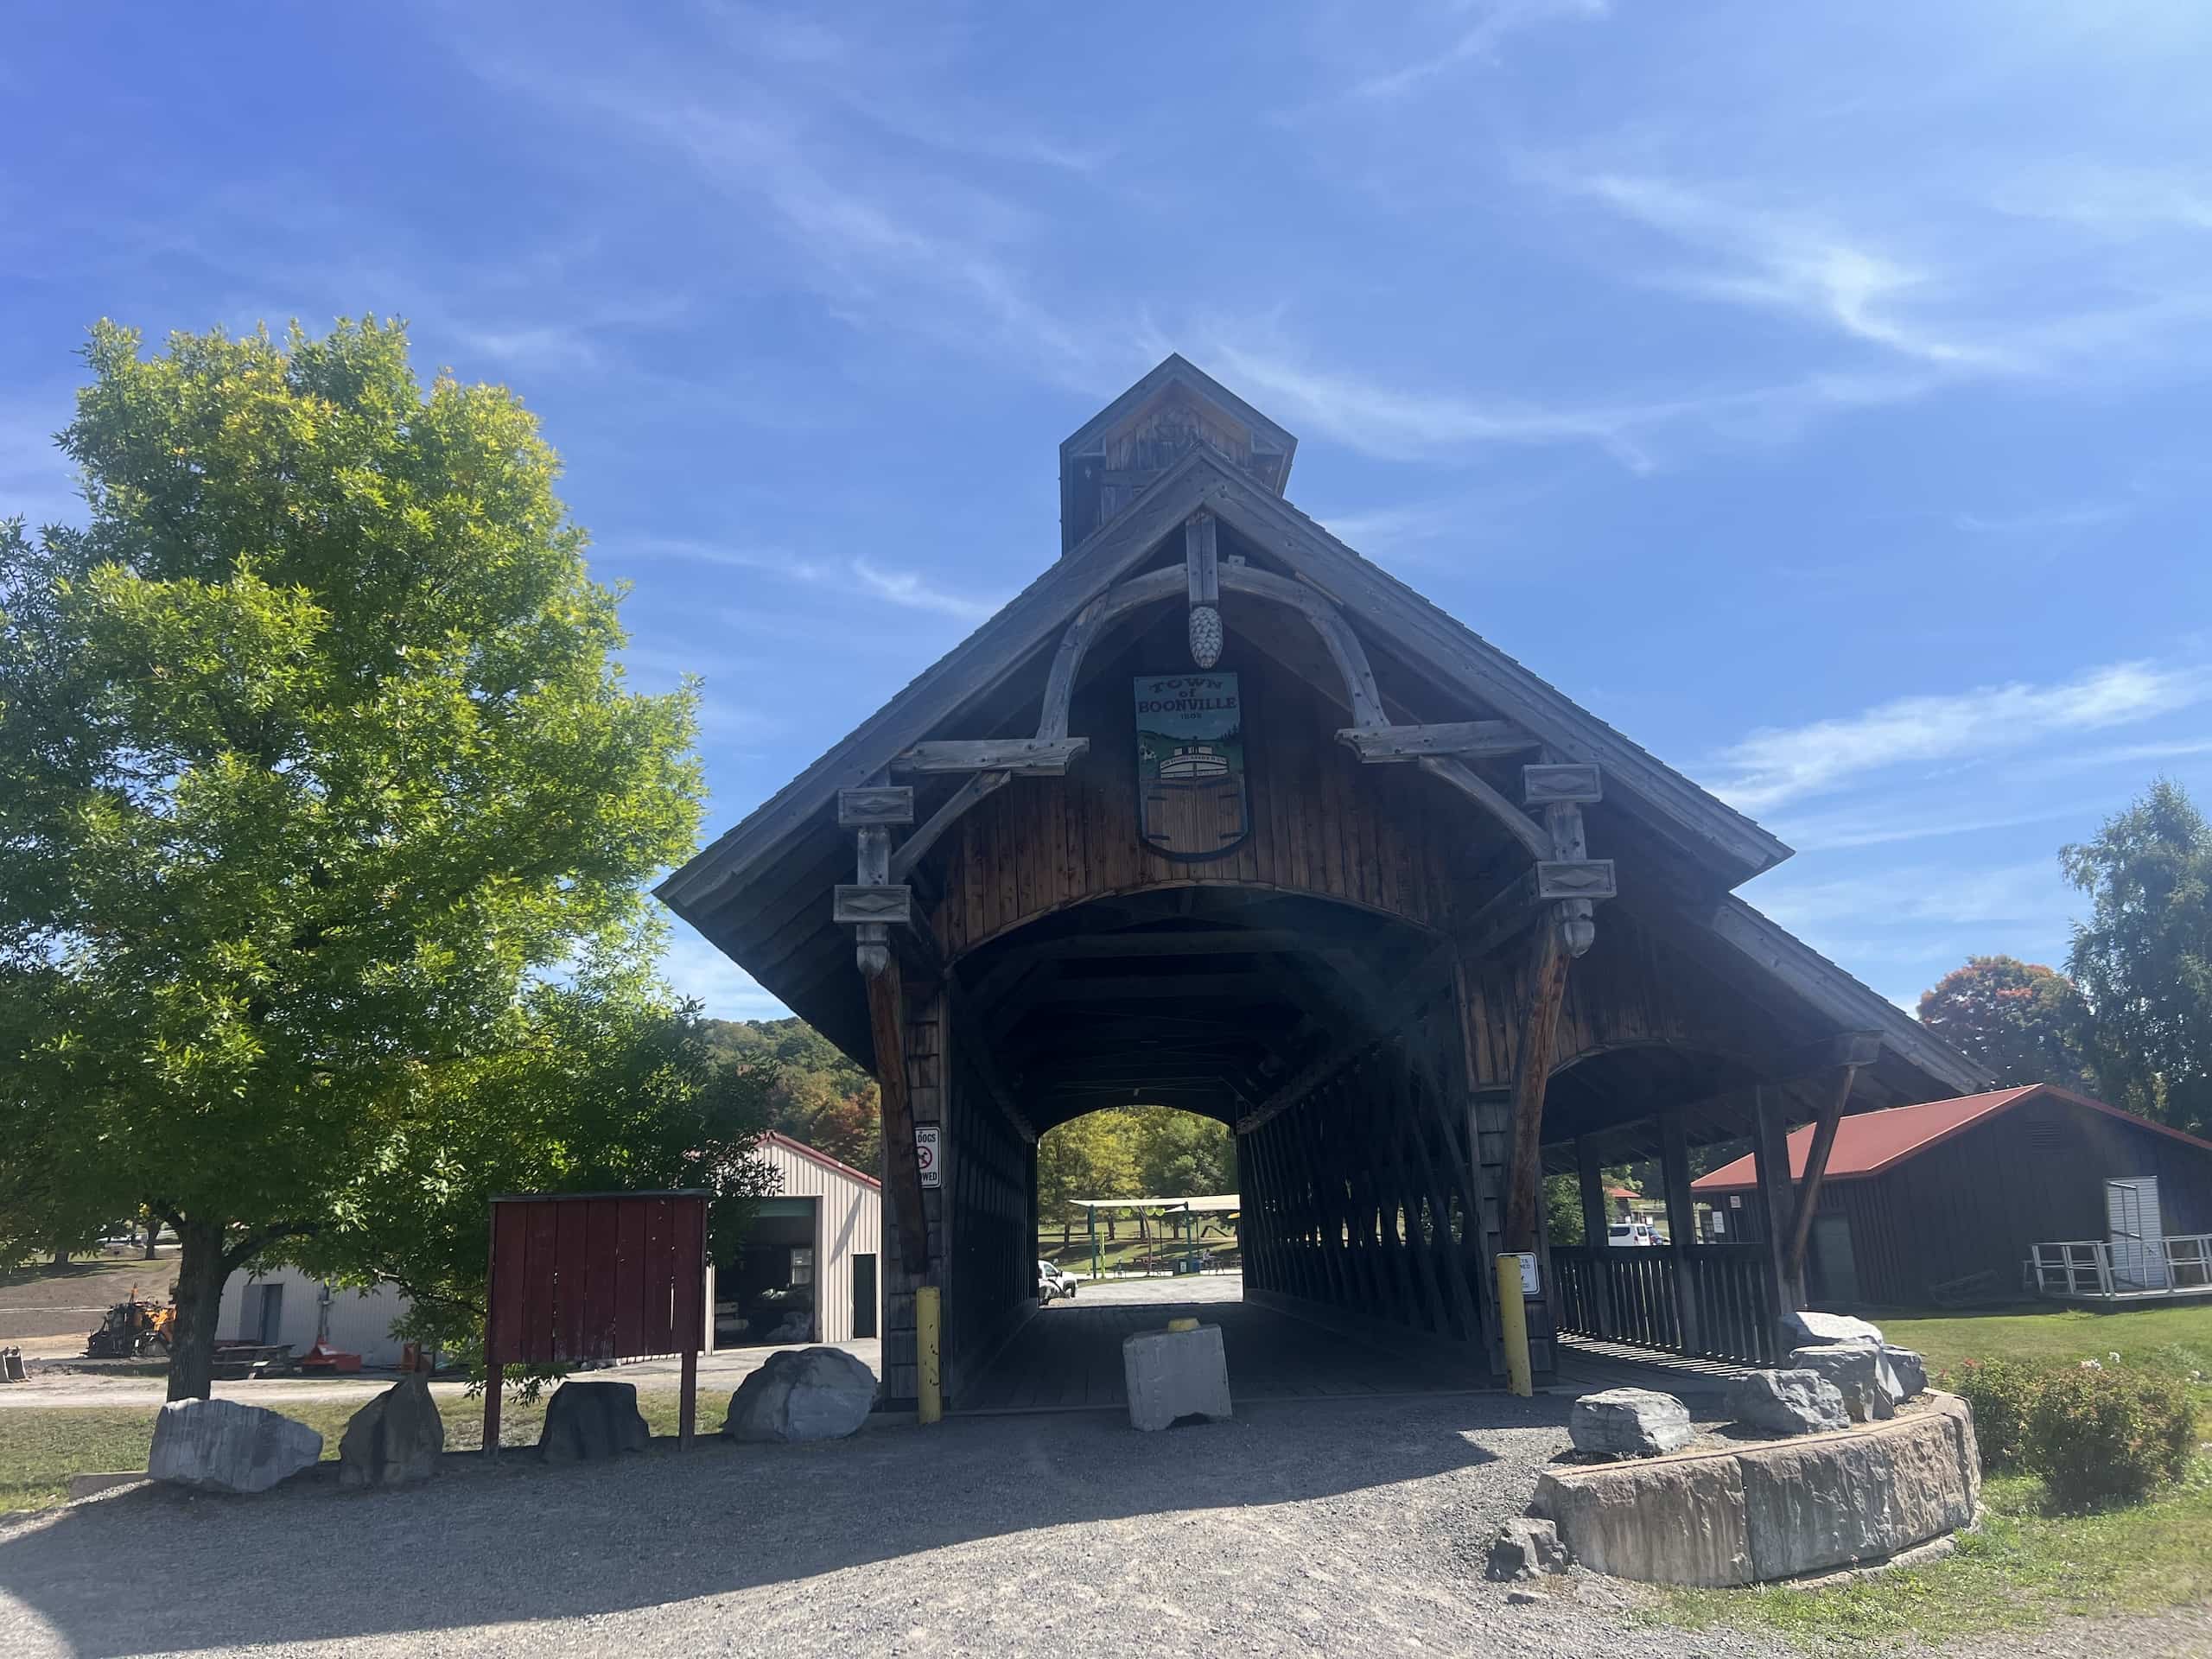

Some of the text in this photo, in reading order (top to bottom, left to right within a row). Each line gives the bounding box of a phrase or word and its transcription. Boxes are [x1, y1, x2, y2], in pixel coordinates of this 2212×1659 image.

[1148, 677, 1224, 693] TOWN
[1139, 698, 1237, 713] BOONVILLE
[918, 1134, 936, 1142] DOGS
